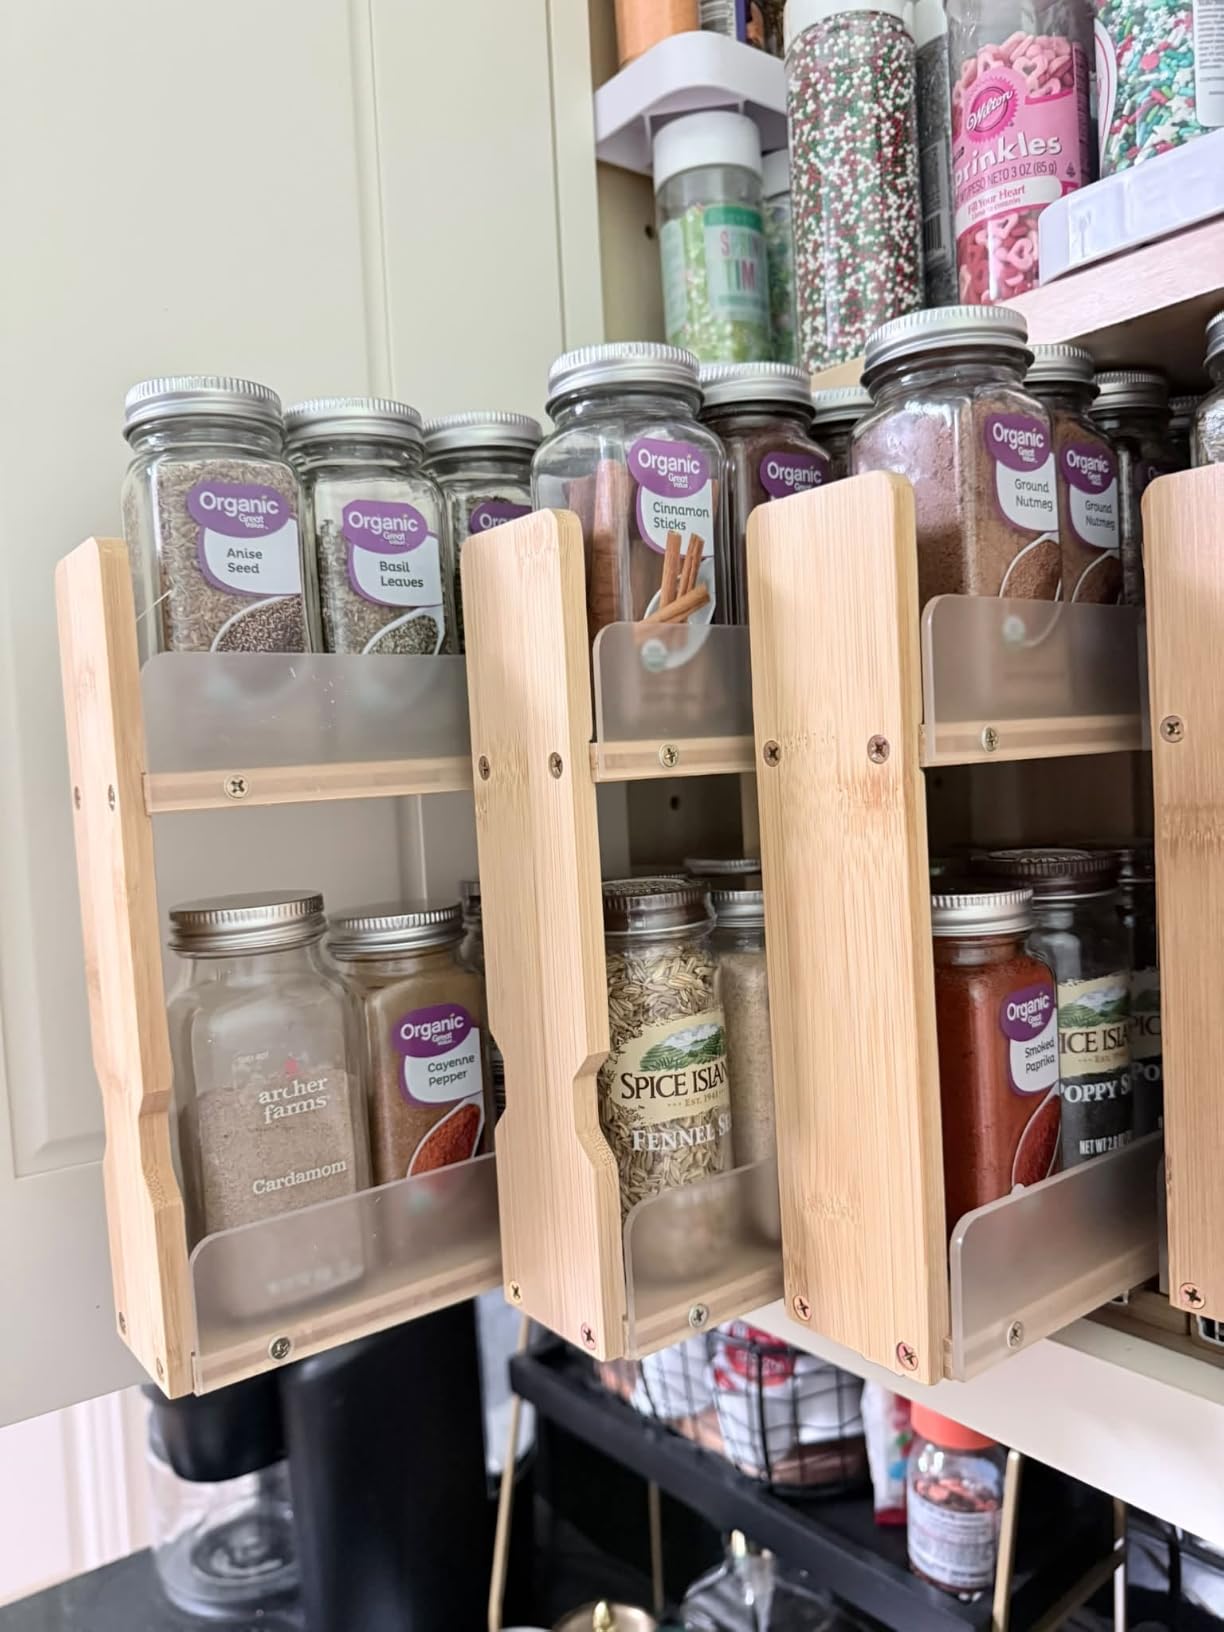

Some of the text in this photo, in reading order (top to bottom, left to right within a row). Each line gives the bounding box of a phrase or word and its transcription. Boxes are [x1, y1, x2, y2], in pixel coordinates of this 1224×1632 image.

[966, 89, 1014, 131] Wilton
[954, 131, 1063, 190] prinkles
[1011, 165, 1017, 178] 3
[1019, 163, 1033, 177] OZ
[999, 185, 1025, 198] Heart
[992, 422, 1045, 450] Organic
[638, 449, 700, 476] Organic
[1066, 449, 1110, 474] Organic
[767, 461, 823, 487] Organic
[1014, 478, 1050, 493] Ground
[199, 491, 279, 517] Organic
[653, 501, 710, 518] Cinnamon
[1015, 495, 1053, 512] Nutmeg
[1085, 499, 1112, 514] Ground
[348, 511, 419, 535] Organic
[653, 516, 687, 531] Sticks
[1085, 515, 1115, 531] Nutmeg
[226, 547, 263, 560] Anise
[227, 562, 260, 574] Seed
[379, 560, 410, 573] Basil
[380, 576, 424, 588] Leaves
[1006, 991, 1049, 1022] Organic
[400, 1012, 464, 1041] Organic
[1024, 1037, 1055, 1059] Smoked
[1059, 1026, 1129, 1054] ICE ISLA
[427, 1054, 475, 1073] Cayenne
[1025, 1053, 1055, 1074] Paprika
[428, 1070, 468, 1087] Pepper
[620, 1061, 729, 1099] SPICE ISLAN
[258, 1077, 329, 1104] archer
[263, 1095, 328, 1125] farms
[631, 1123, 716, 1152] FENNEL
[252, 1159, 347, 1195] Cardamom
